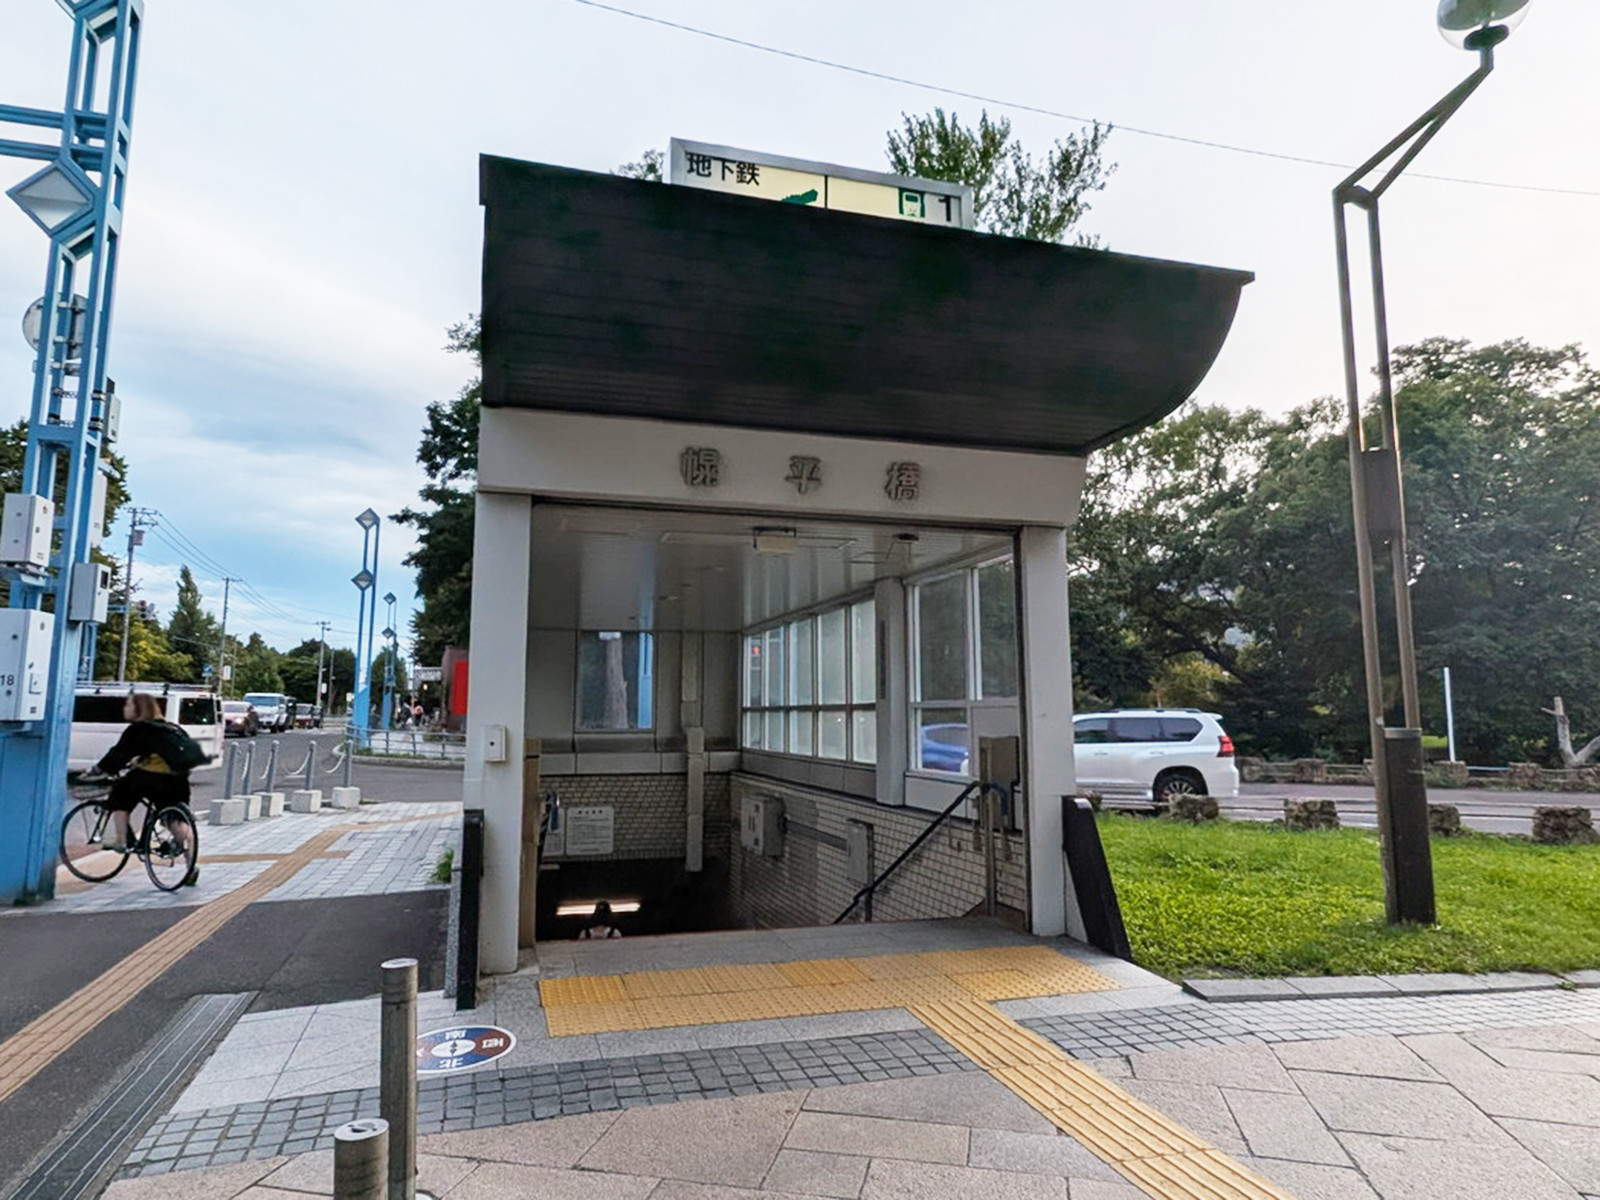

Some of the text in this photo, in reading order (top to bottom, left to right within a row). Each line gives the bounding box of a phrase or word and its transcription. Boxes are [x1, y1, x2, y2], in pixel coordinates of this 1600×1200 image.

[685, 150, 760, 186] 地下鉄
[939, 195, 953, 222] 1
[679, 446, 923, 500] 幌平橋
